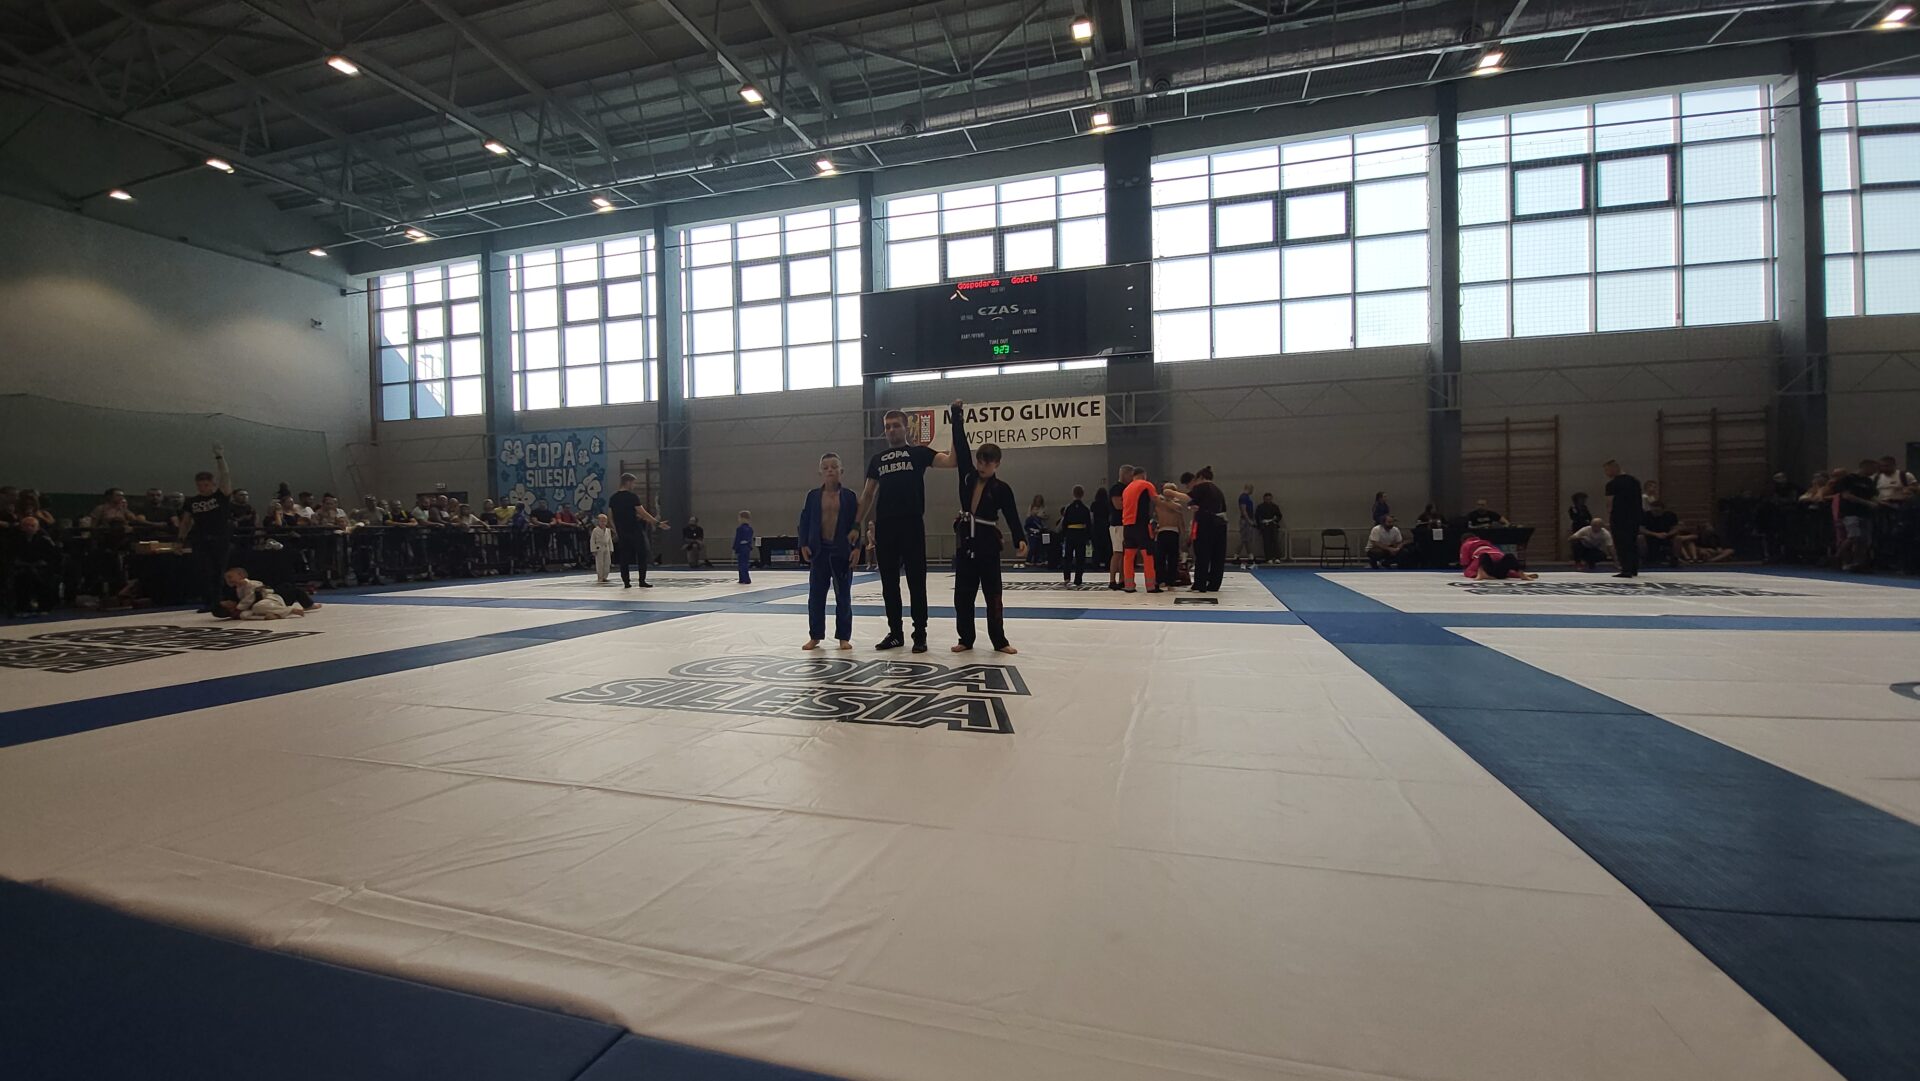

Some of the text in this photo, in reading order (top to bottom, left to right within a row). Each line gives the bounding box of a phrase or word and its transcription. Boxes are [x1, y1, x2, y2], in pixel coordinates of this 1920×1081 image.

[977, 304, 1020, 316] CZAS
[943, 401, 1101, 424] MASTO GLIWICE
[1031, 425, 1081, 442] SPORT
[525, 441, 576, 468] COPA
[880, 450, 911, 462] COPA
[526, 467, 577, 488] SILESIA
[668, 655, 1032, 696] COPA
[546, 677, 1015, 735] SILESIA
